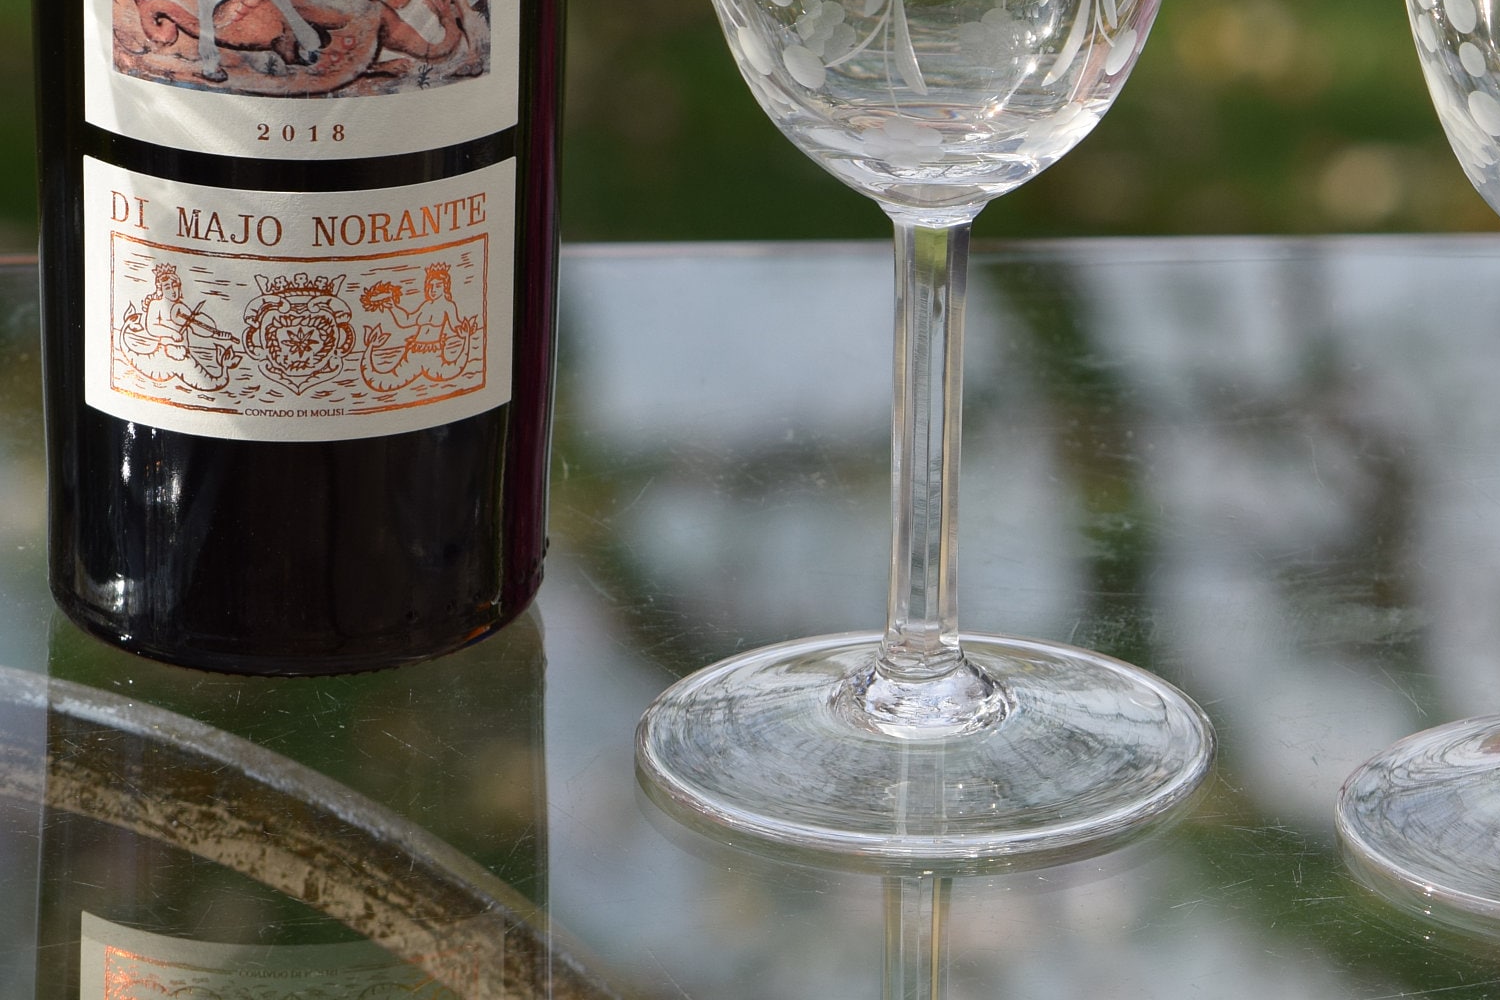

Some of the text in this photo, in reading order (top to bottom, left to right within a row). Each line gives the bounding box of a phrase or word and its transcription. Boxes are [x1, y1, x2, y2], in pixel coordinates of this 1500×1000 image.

[256, 122, 347, 142] 2018
[110, 190, 488, 247] DI MAJO NORANTE
[245, 408, 345, 419] CONTADO DI MOLISI
